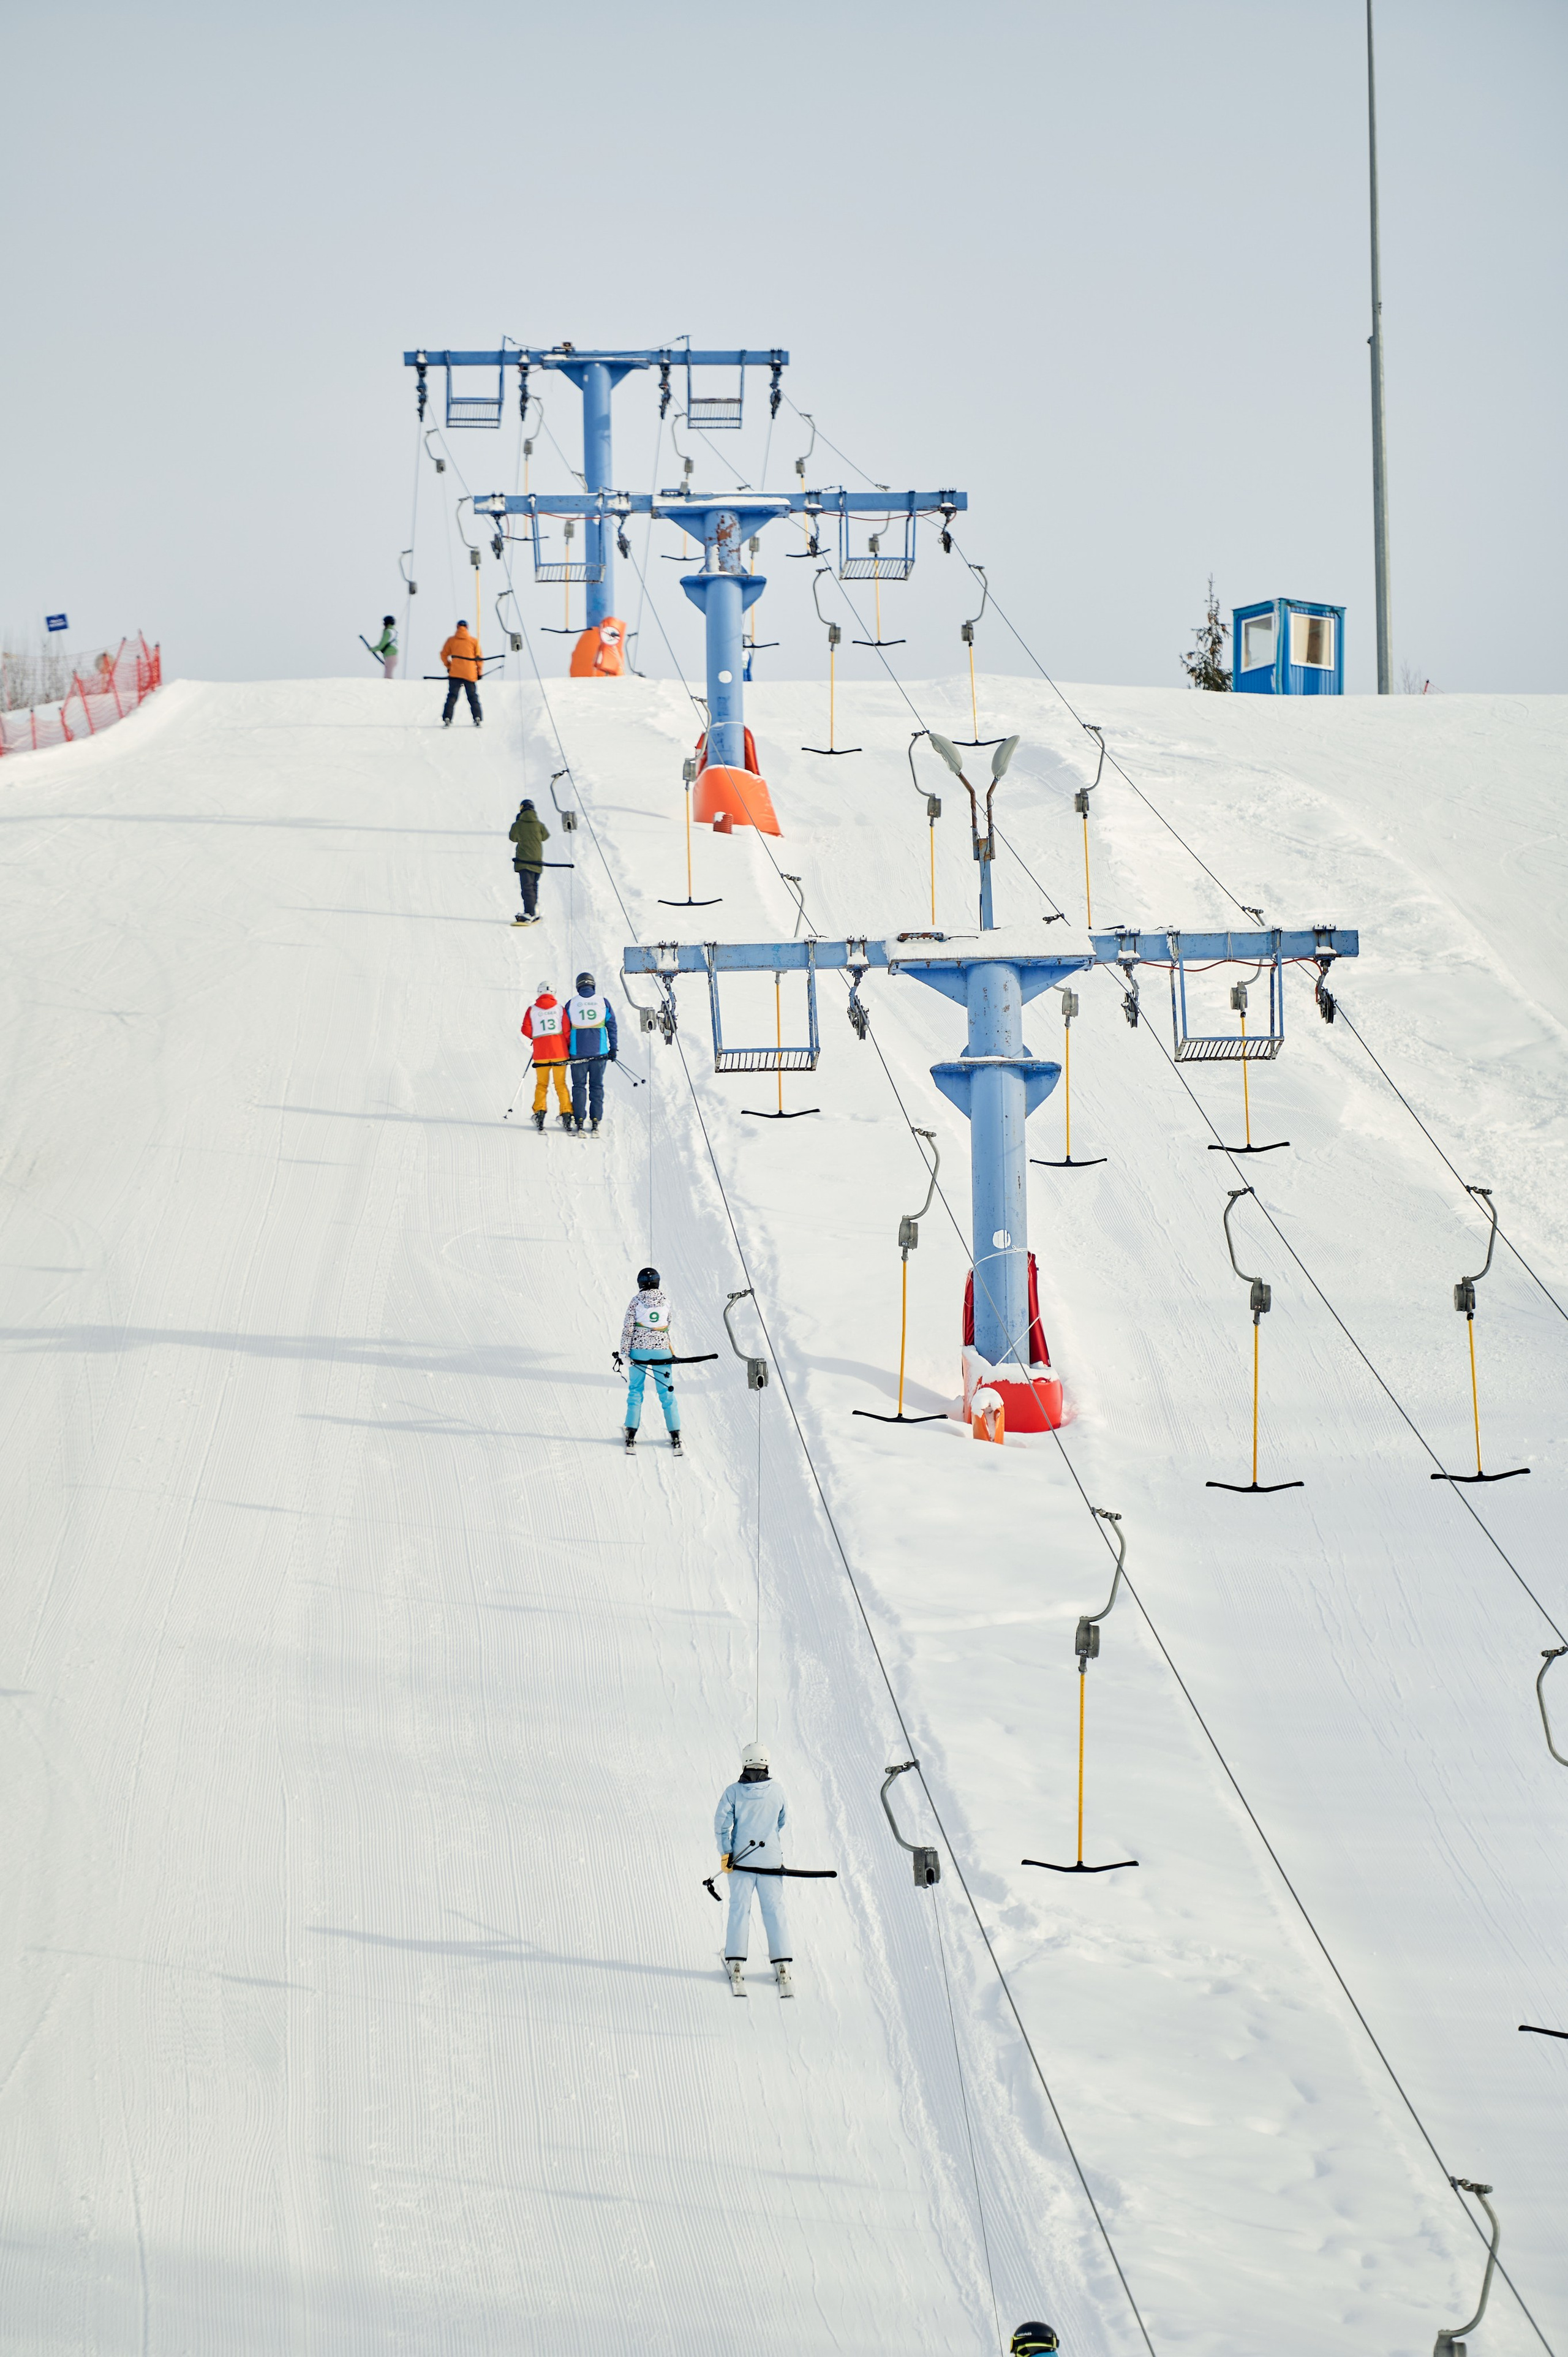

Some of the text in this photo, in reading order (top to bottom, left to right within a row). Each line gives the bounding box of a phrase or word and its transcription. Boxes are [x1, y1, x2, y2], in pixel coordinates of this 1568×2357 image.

[579, 1009, 597, 1020] 19
[540, 1019, 556, 1031] 13
[649, 1311, 660, 1322] 9
